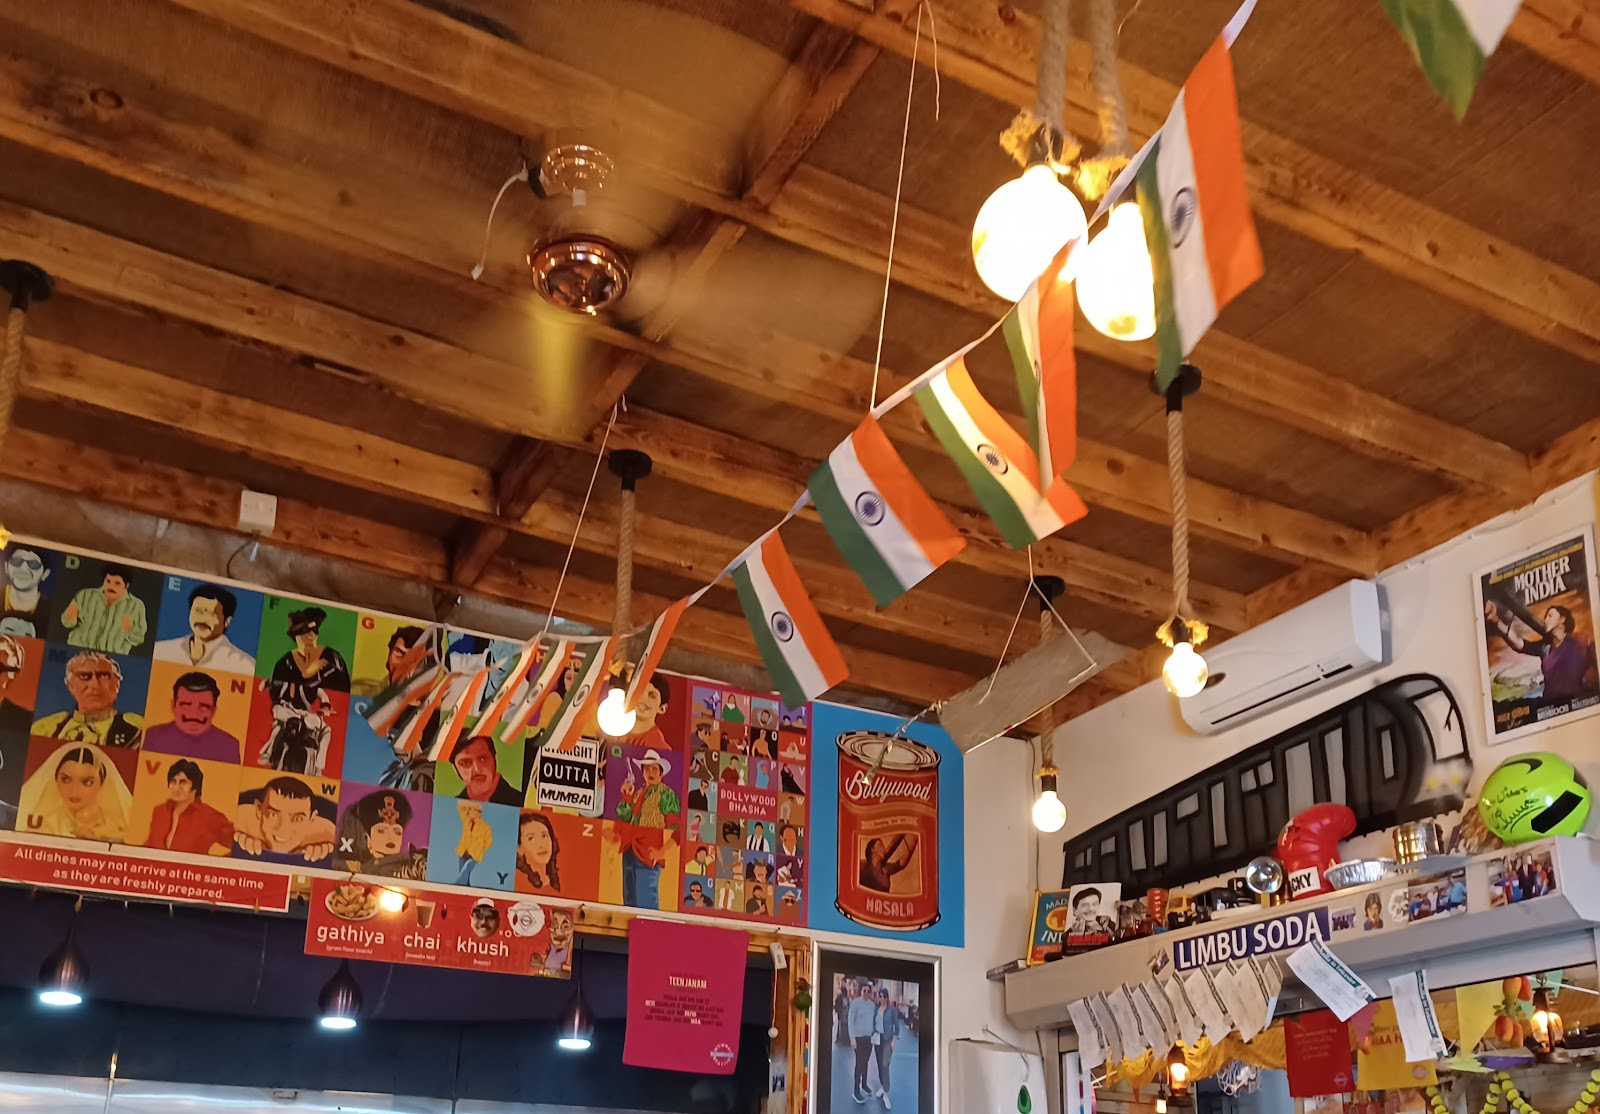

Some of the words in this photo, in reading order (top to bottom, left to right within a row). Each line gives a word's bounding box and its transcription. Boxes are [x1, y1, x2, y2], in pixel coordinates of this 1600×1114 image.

[65, 555, 80, 569] D
[1514, 556, 1571, 593] MOTHER
[168, 576, 181, 592] E
[1524, 575, 1566, 606] INDIA
[361, 618, 375, 630] G
[230, 679, 246, 694] N
[801, 707, 806, 716] T
[744, 726, 748, 736] I
[771, 732, 777, 741] O
[800, 737, 806, 746] U
[712, 752, 718, 761] C
[742, 757, 748, 766] J
[145, 760, 160, 775] V
[771, 761, 776, 770] P
[799, 768, 806, 776] V
[543, 762, 590, 784] OUTTA
[321, 783, 336, 796] W
[845, 770, 932, 803] Bollywood
[540, 788, 592, 806] MUMBAI
[721, 789, 776, 807] BOLLYWOOD
[796, 797, 804, 805] W
[729, 801, 766, 816] BHASHA
[27, 815, 43, 829] U
[710, 814, 715, 824] E
[740, 819, 745, 828] K
[582, 824, 593, 836] Z
[339, 838, 354, 852] X
[739, 850, 744, 860] L
[14, 847, 32, 860] All
[35, 850, 76, 865] dishes
[80, 858, 106, 870] may
[108, 861, 127, 871] not
[130, 864, 167, 877] arrive
[169, 870, 180, 879] at
[183, 870, 201, 882] the
[204, 874, 236, 886] same
[239, 877, 264, 889] time
[797, 859, 803, 868] Y
[53, 869, 68, 879] as
[71, 870, 97, 885] they
[100, 875, 120, 885] are
[123, 876, 165, 893] freshly
[168, 882, 225, 899] prepared.
[497, 872, 509, 885] Y
[1291, 873, 1311, 892] CKY
[768, 886, 773, 895] S
[866, 898, 914, 917] MASALA
[1045, 899, 1068, 910] MAD
[317, 925, 384, 947] gathiya
[404, 932, 440, 950] chai
[457, 936, 508, 957] khush
[1179, 927, 1247, 968] LIMBU
[1254, 911, 1324, 952] SODA
[669, 976, 684, 987] TEEN
[685, 978, 707, 989] JANAM
